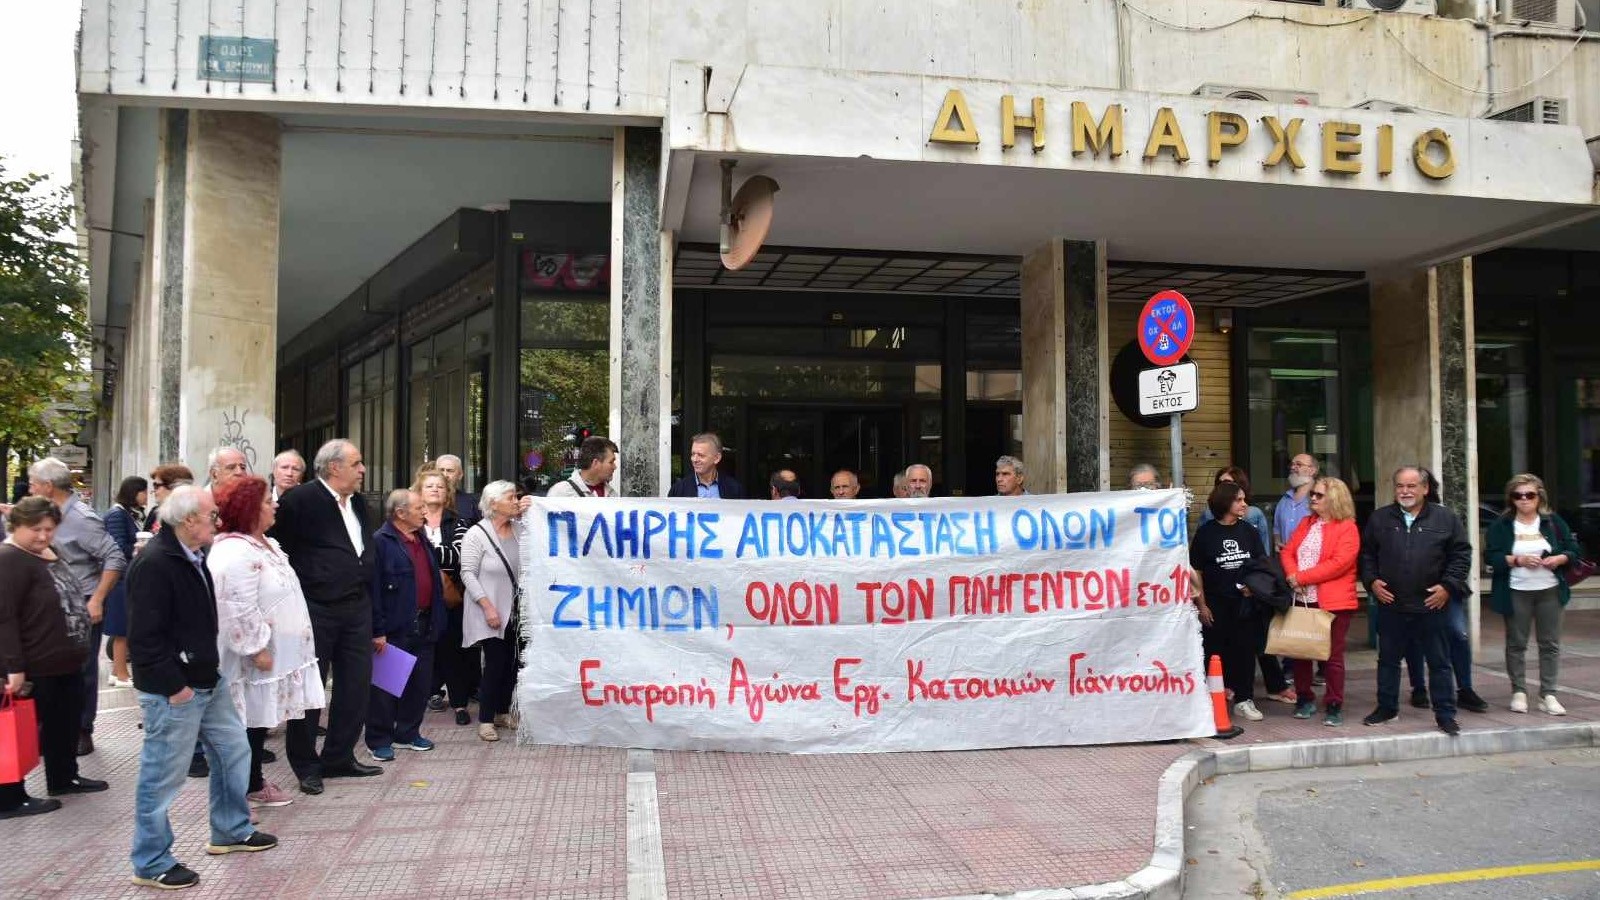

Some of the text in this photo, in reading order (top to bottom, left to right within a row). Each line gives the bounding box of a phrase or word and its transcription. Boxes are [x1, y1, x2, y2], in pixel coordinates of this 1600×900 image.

[928, 88, 1456, 181] ΔΗΜΑΡΧΕΙΟ
[1152, 305, 1176, 318] ΕΚΤΟΣ
[1153, 397, 1182, 409] ΕΚΤΟΣ
[1160, 383, 1174, 393] EV
[547, 510, 724, 560] ΠΛΗΡΗΣ
[736, 510, 999, 559] ΑΠΟΚΑΤΑΣΤΑΣΗ
[1011, 508, 1116, 550] ΟΛΩΝ
[745, 580, 840, 626] ΟΛΩΝ
[856, 579, 935, 625] ΤΩΝ
[949, 568, 1131, 617] ΠΛΗΓΕΝΤΩΝ
[580, 659, 716, 722] Επιτροπή
[728, 657, 822, 723] Αγώνα
[834, 657, 891, 717] Εργ.
[907, 659, 1055, 702] Κατοικιών
